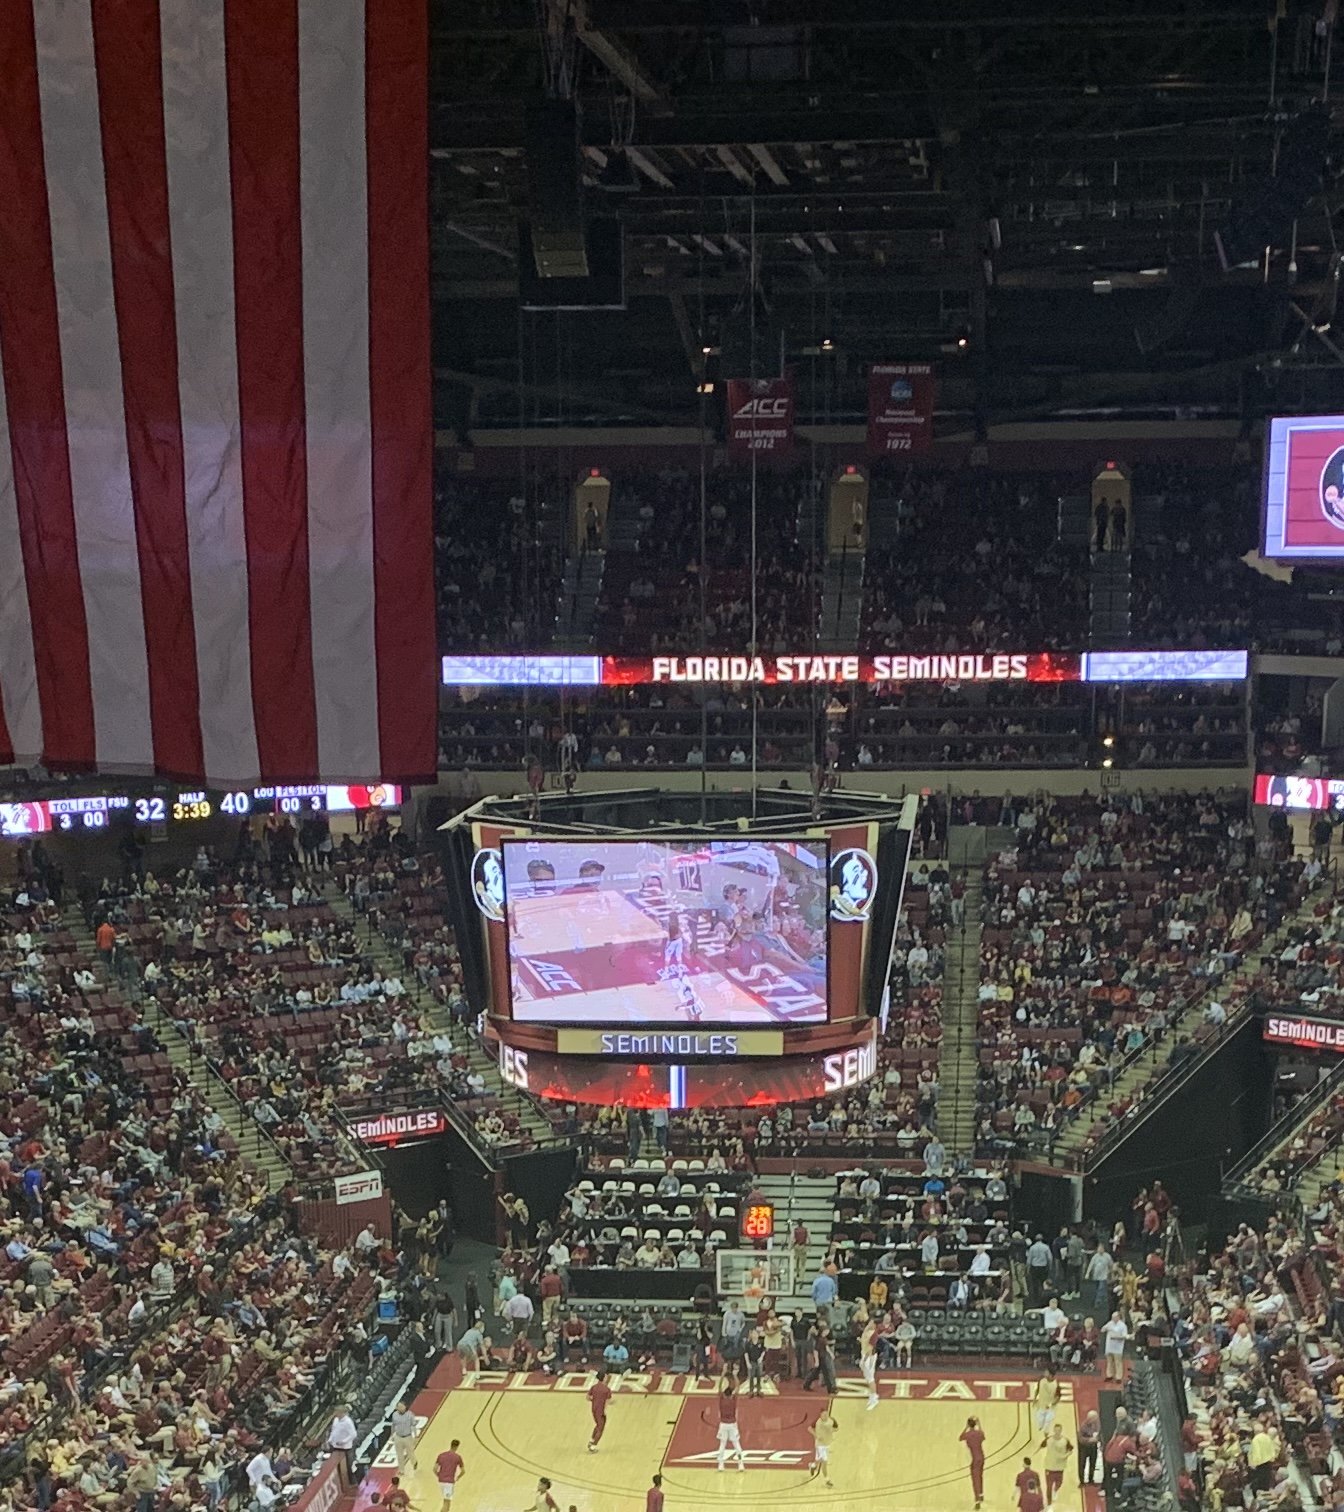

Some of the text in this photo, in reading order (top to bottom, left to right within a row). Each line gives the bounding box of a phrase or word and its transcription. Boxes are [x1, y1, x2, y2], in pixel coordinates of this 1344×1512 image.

[734, 398, 788, 416] ACC
[652, 653, 1027, 682] FLORIDA STATE SEMINOLES
[179, 792, 205, 803] HALF
[254, 786, 274, 798] LOU
[135, 799, 165, 820] 32
[173, 802, 211, 820] 3:39
[220, 792, 249, 814] 40
[60, 813, 71, 828] 3
[601, 1034, 738, 1055] SEMINOLES
[338, 1178, 380, 1196] ESPN
[746, 1217, 767, 1235] 28
